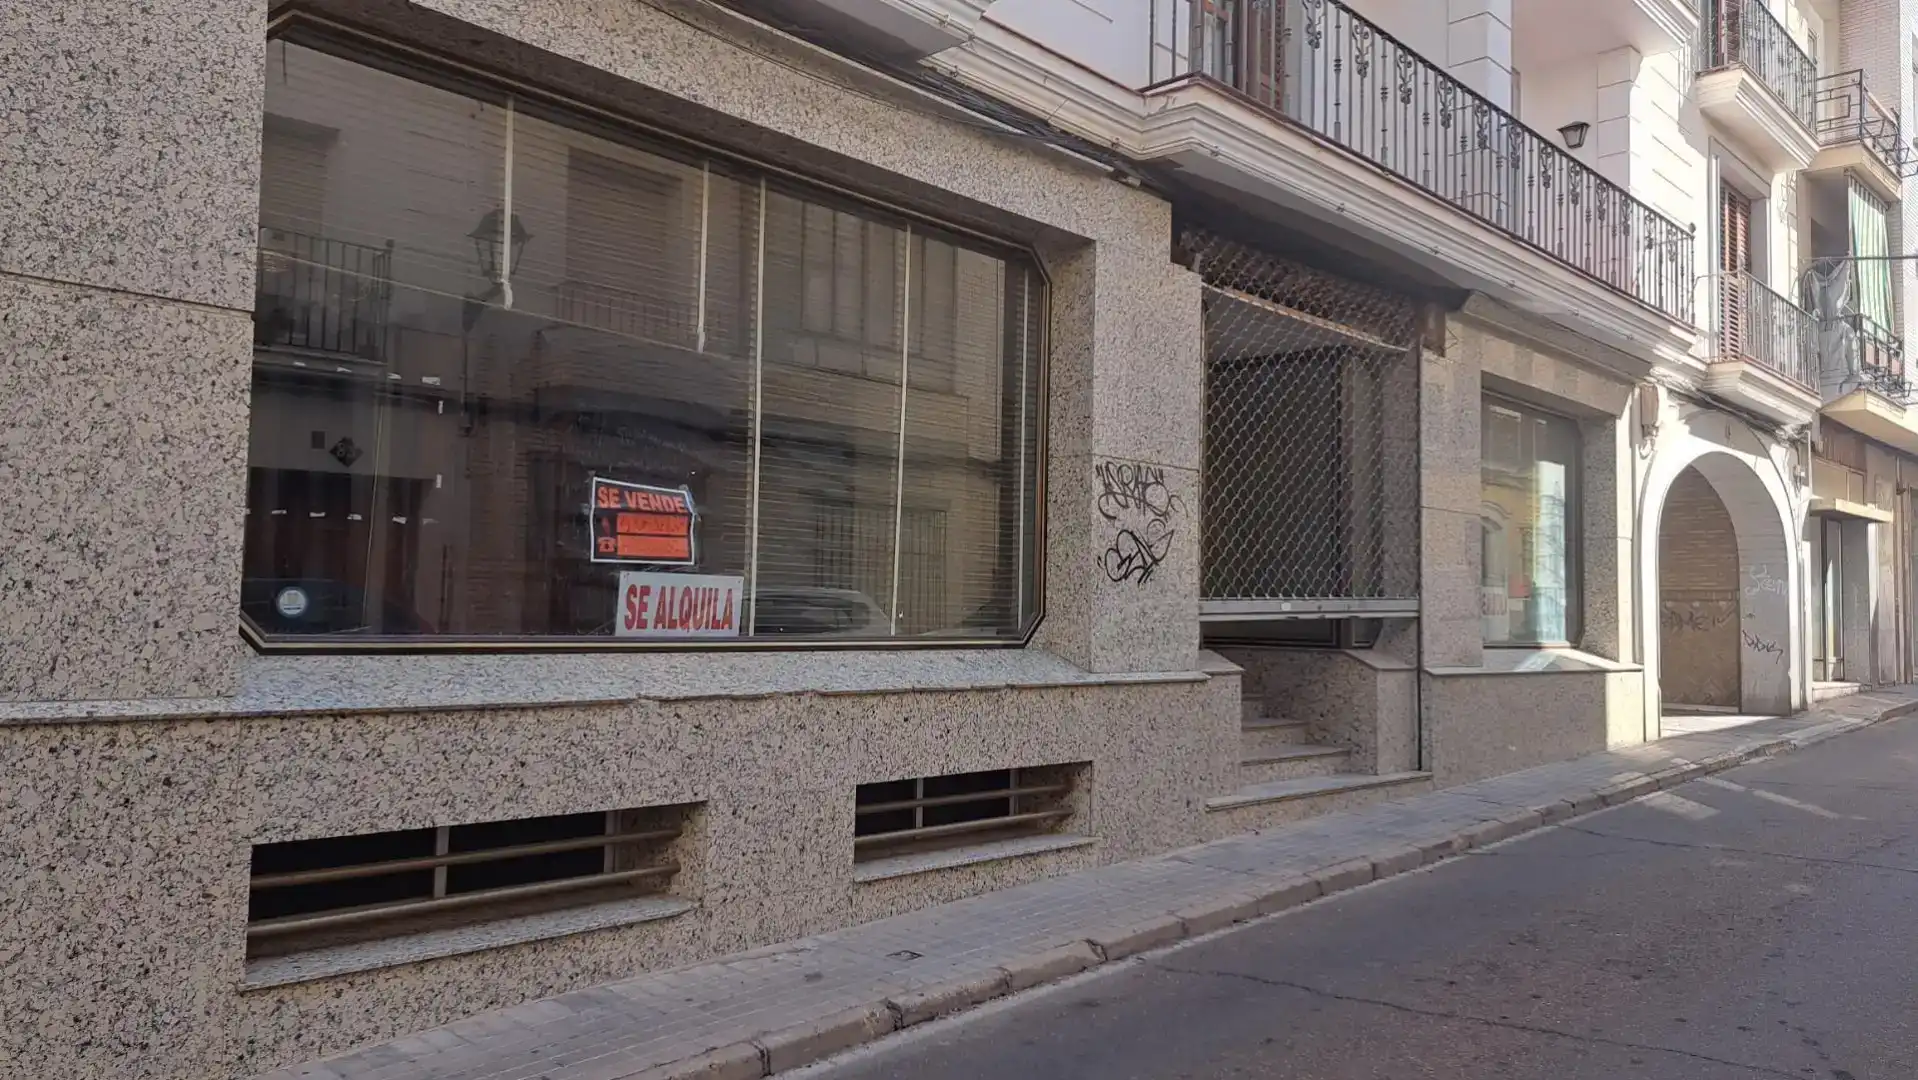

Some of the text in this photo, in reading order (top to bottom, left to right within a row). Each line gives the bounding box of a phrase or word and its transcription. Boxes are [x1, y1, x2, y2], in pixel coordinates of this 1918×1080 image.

[598, 487, 686, 512] SE VENDE
[625, 585, 733, 632] SE ALQUILA
